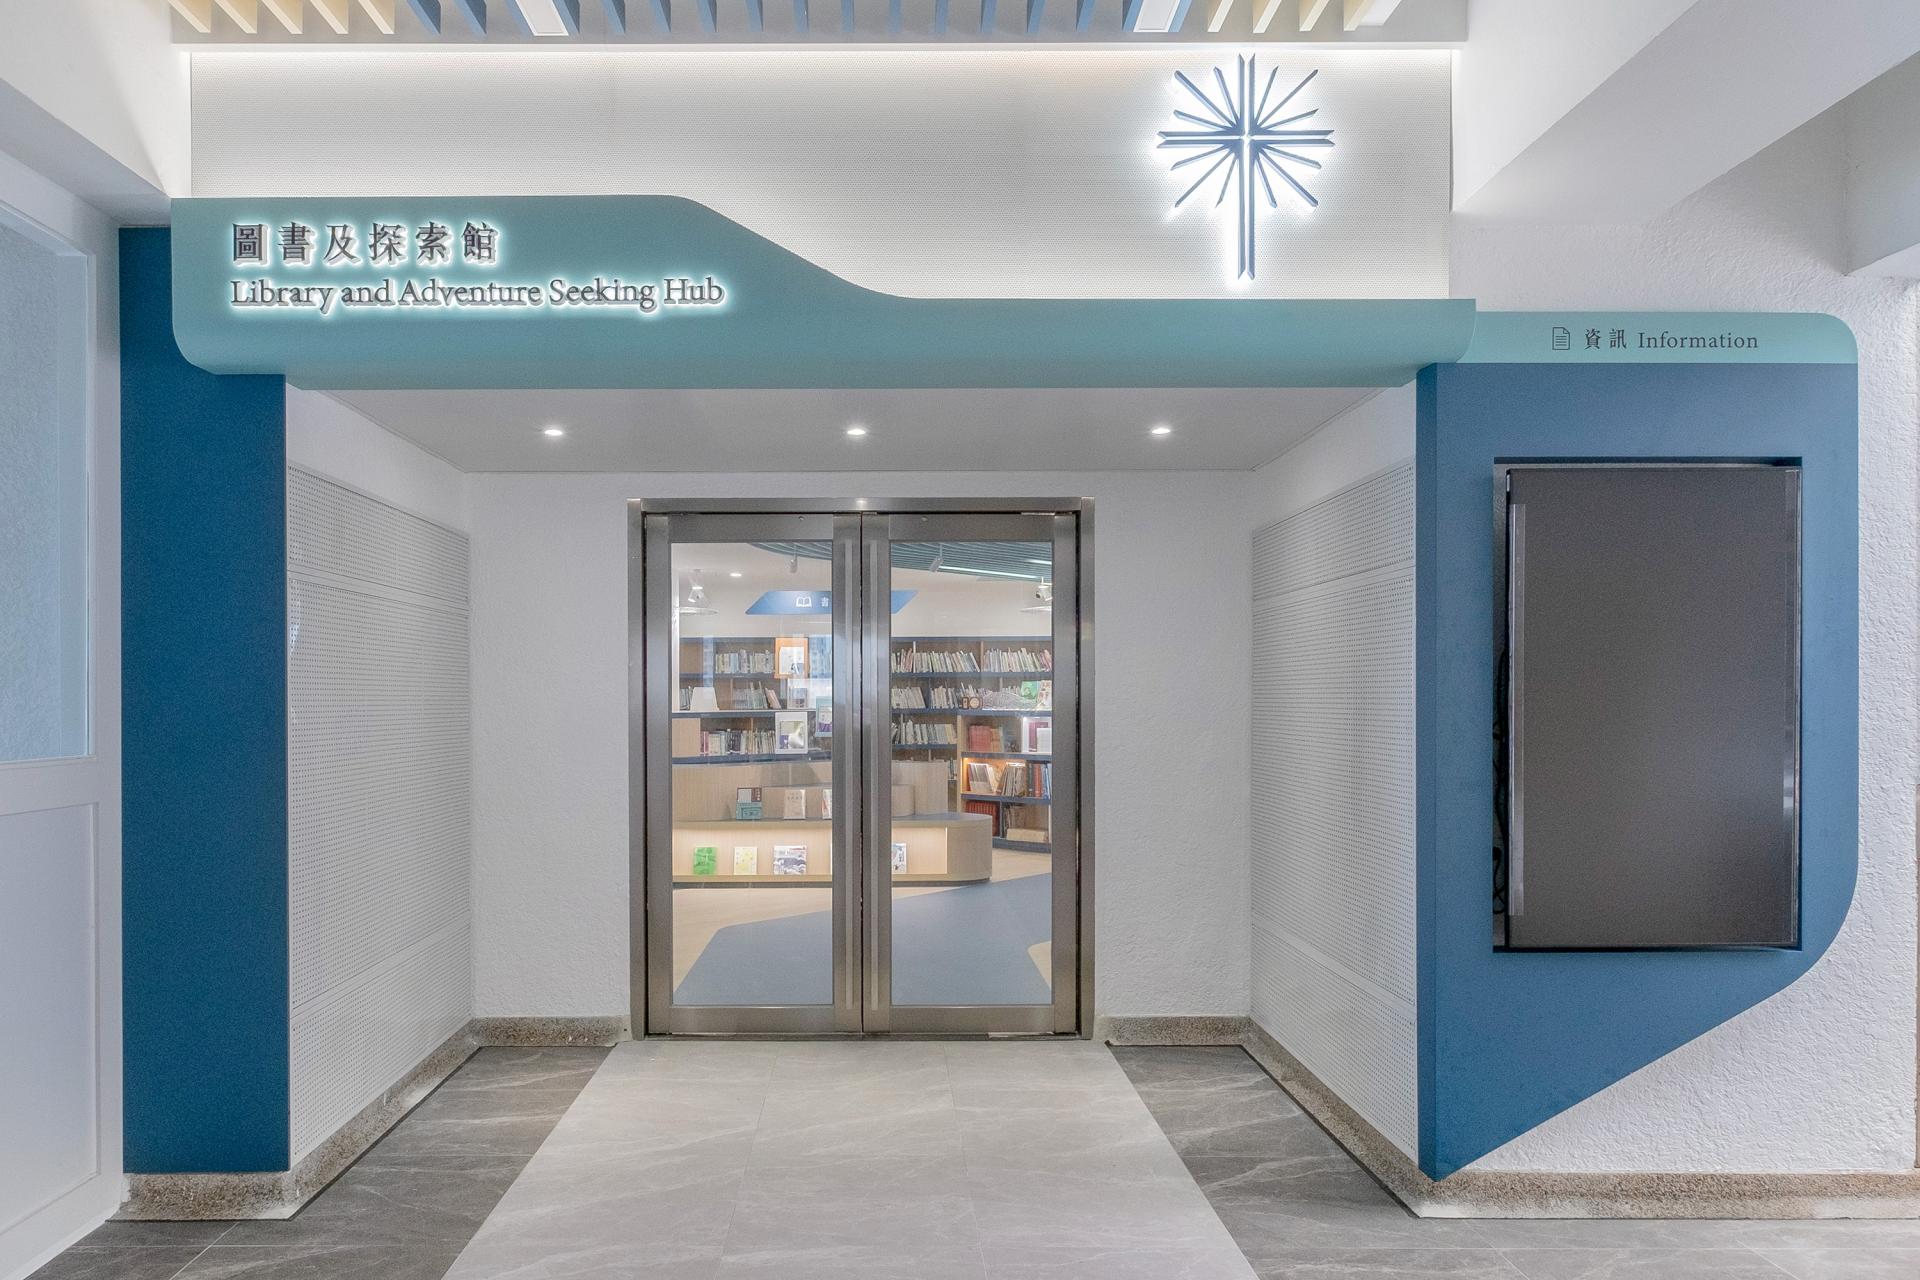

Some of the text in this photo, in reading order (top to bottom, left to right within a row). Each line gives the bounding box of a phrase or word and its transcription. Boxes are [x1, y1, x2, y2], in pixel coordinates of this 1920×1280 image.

[232, 221, 497, 264] 圖書及探索館
[230, 276, 724, 314] Library and Adventure Seeking Hub
[1584, 328, 1627, 349] 資訊
[1637, 330, 1758, 349] Information
